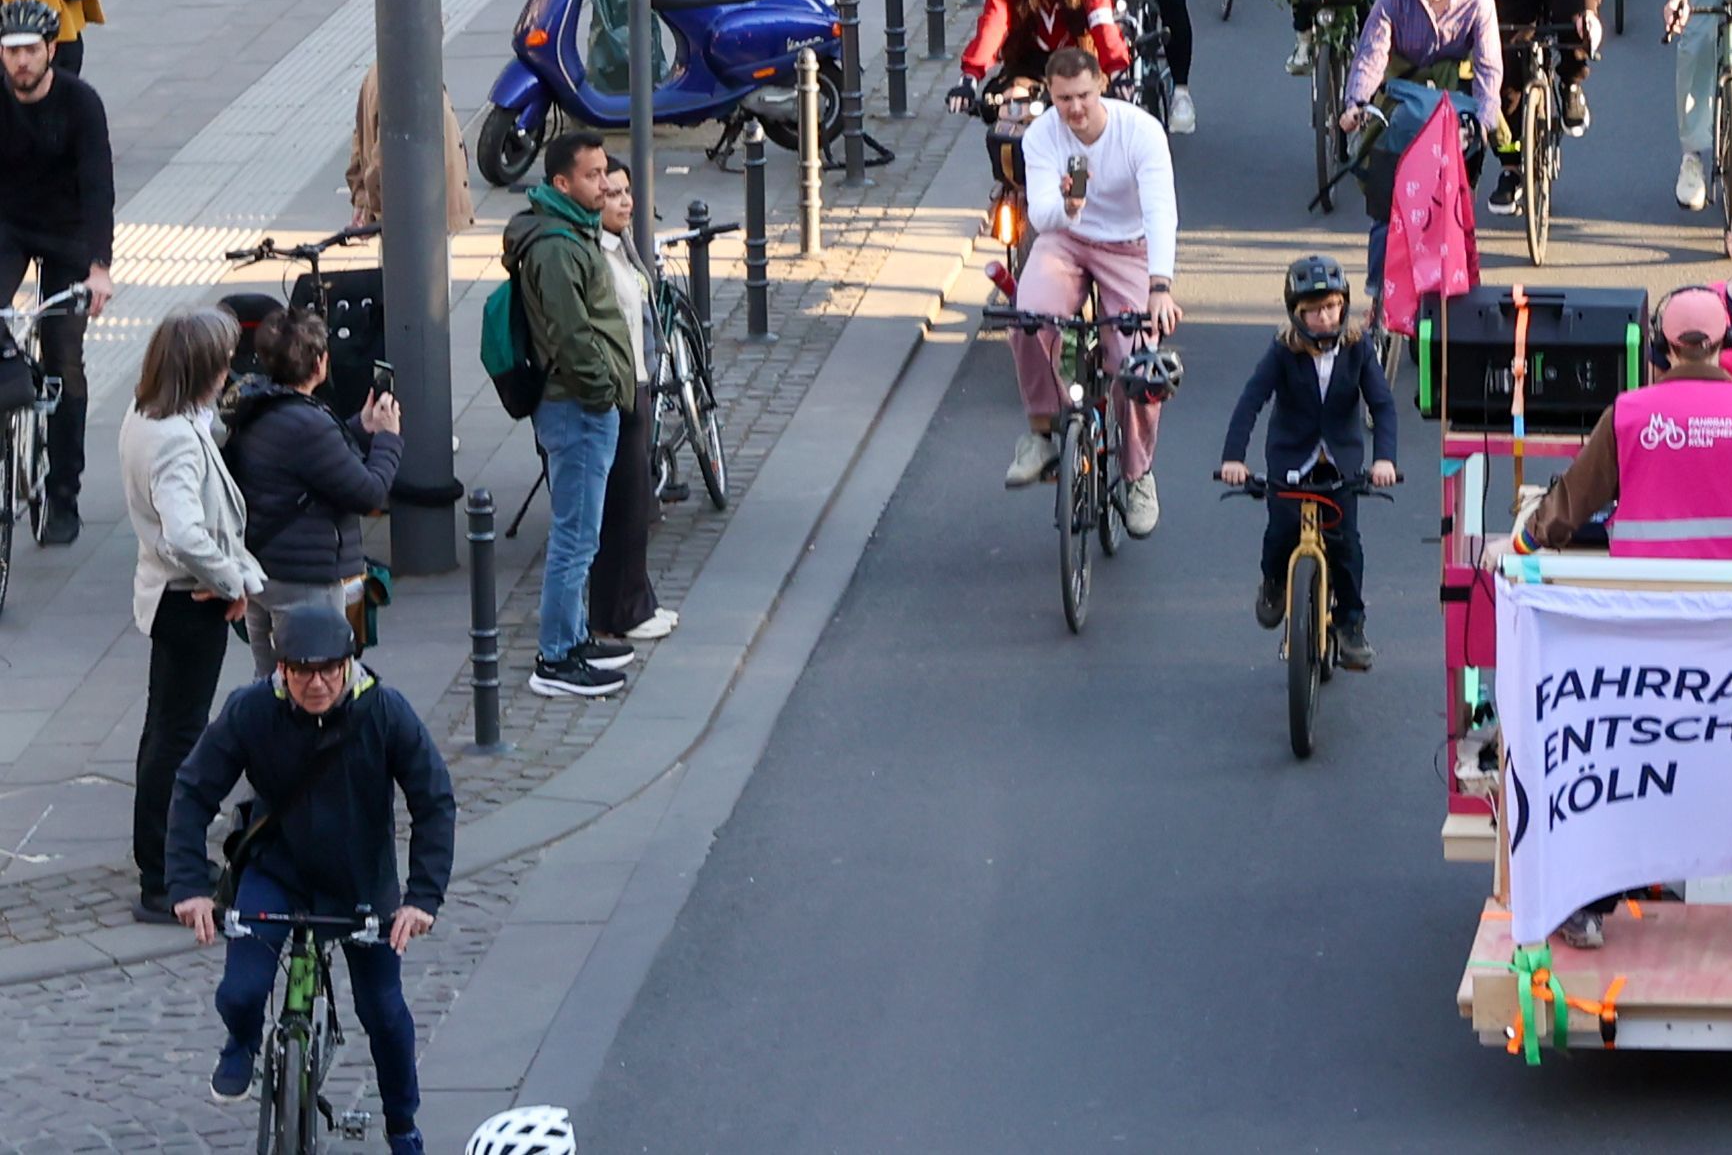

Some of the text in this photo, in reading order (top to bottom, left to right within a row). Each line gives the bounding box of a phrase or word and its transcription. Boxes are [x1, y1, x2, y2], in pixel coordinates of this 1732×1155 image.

[1688, 416, 1732, 427] FAHRRAD
[1688, 438, 1714, 448] KÖLN
[1549, 760, 1679, 833] KÖLN
